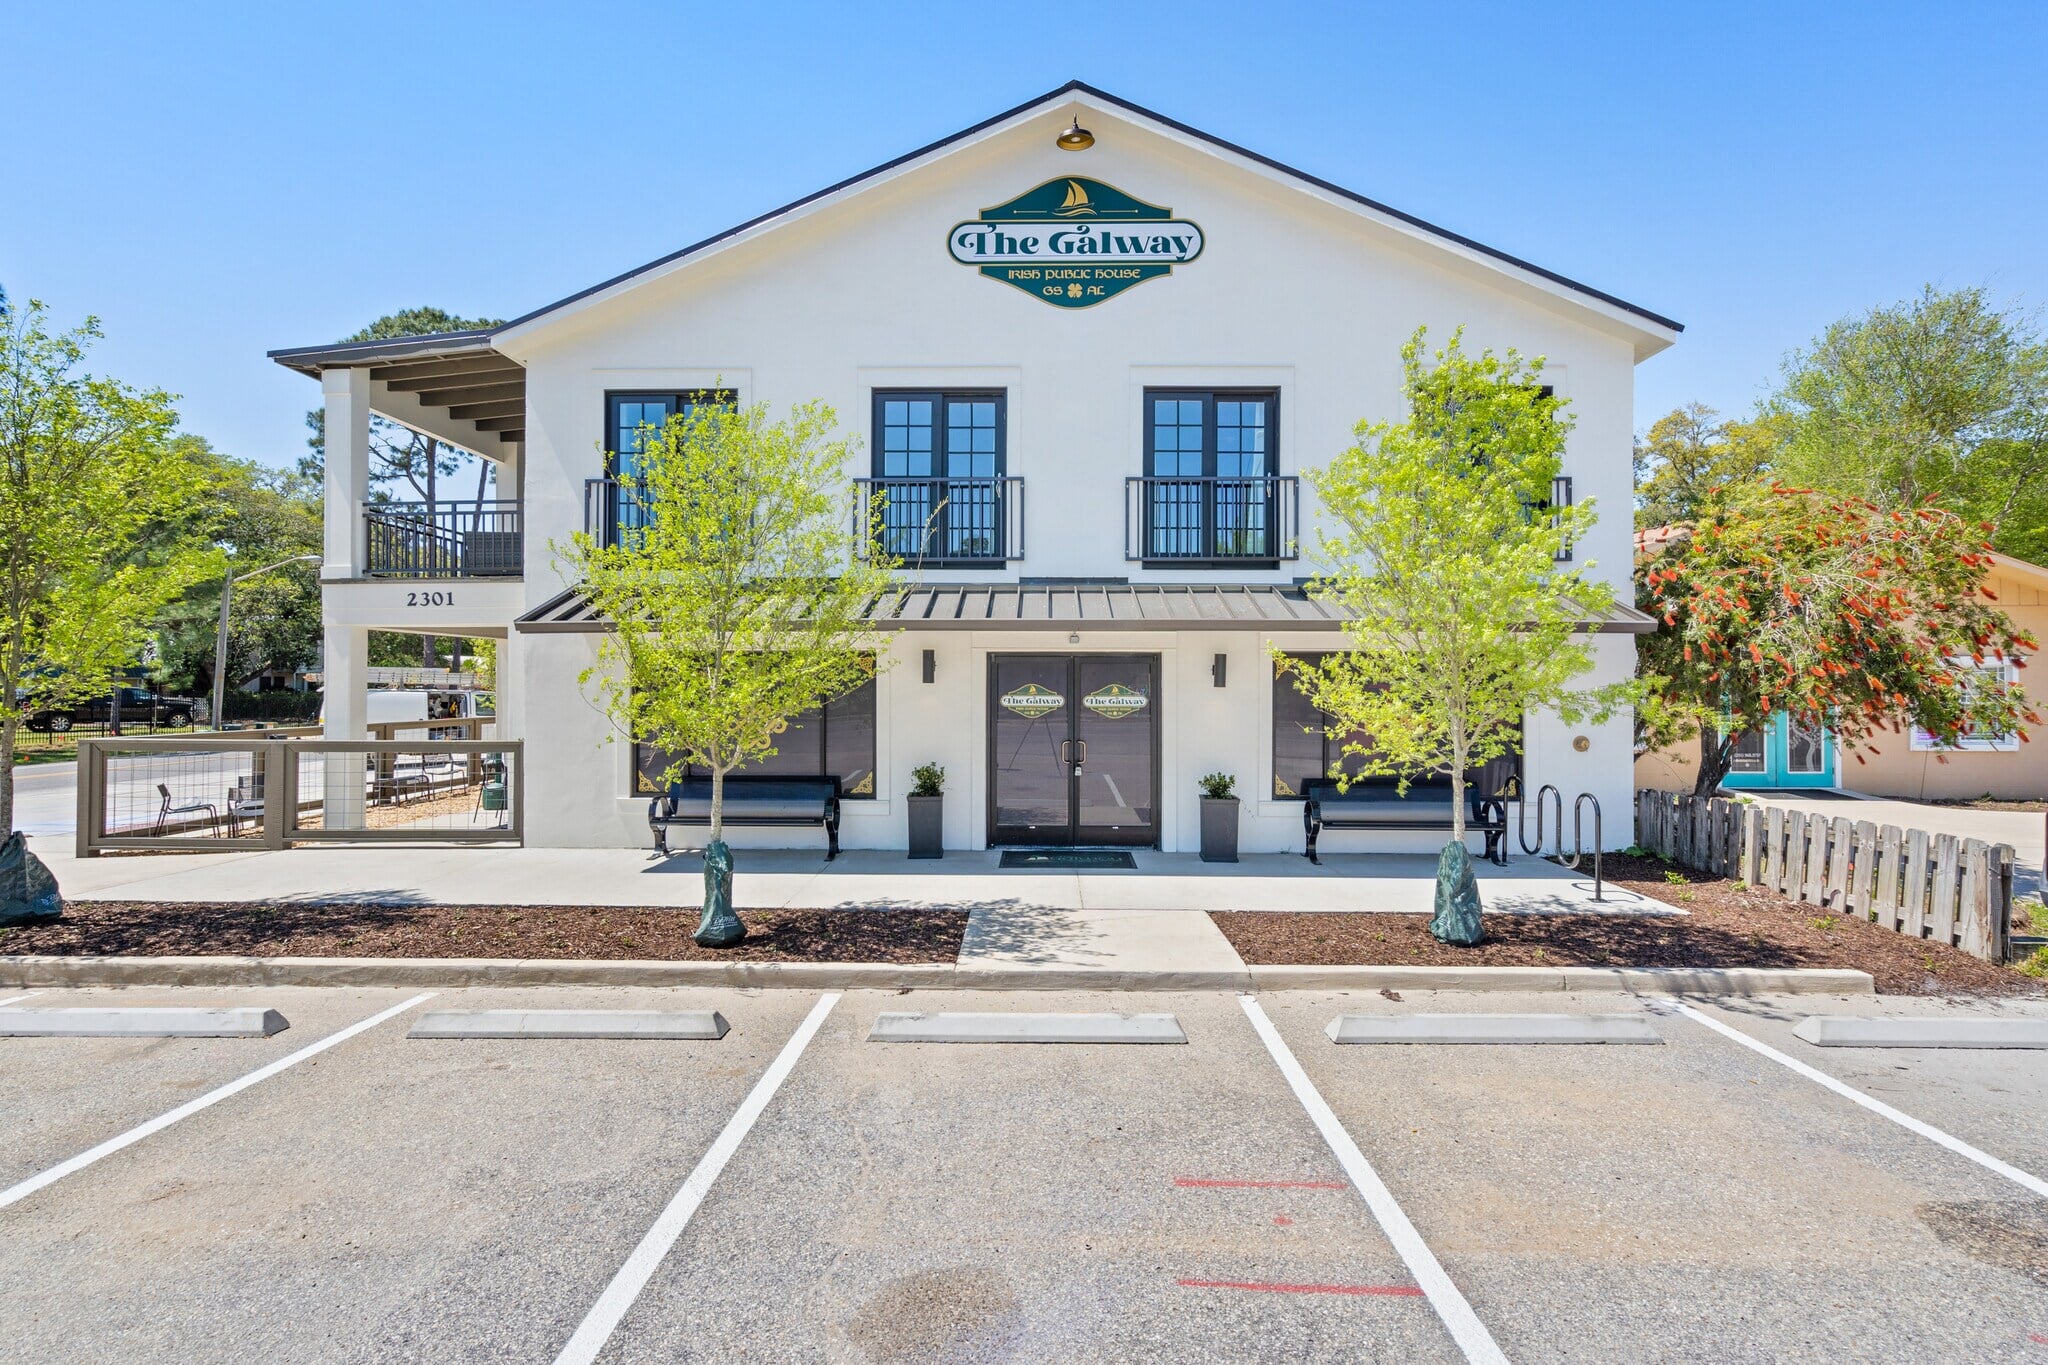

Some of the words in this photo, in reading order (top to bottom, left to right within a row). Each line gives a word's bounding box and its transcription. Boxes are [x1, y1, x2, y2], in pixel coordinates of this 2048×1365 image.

[957, 224, 1040, 255] The
[1048, 225, 1194, 261] Galway
[1008, 269, 1041, 279] IRISH
[1045, 269, 1091, 280] PUBLIC
[1095, 269, 1141, 279] HOUSE
[1042, 286, 1063, 296] GS
[1086, 285, 1105, 295] AL
[407, 592, 455, 606] 2301
[1003, 695, 1024, 704] The
[1086, 695, 1107, 705] The
